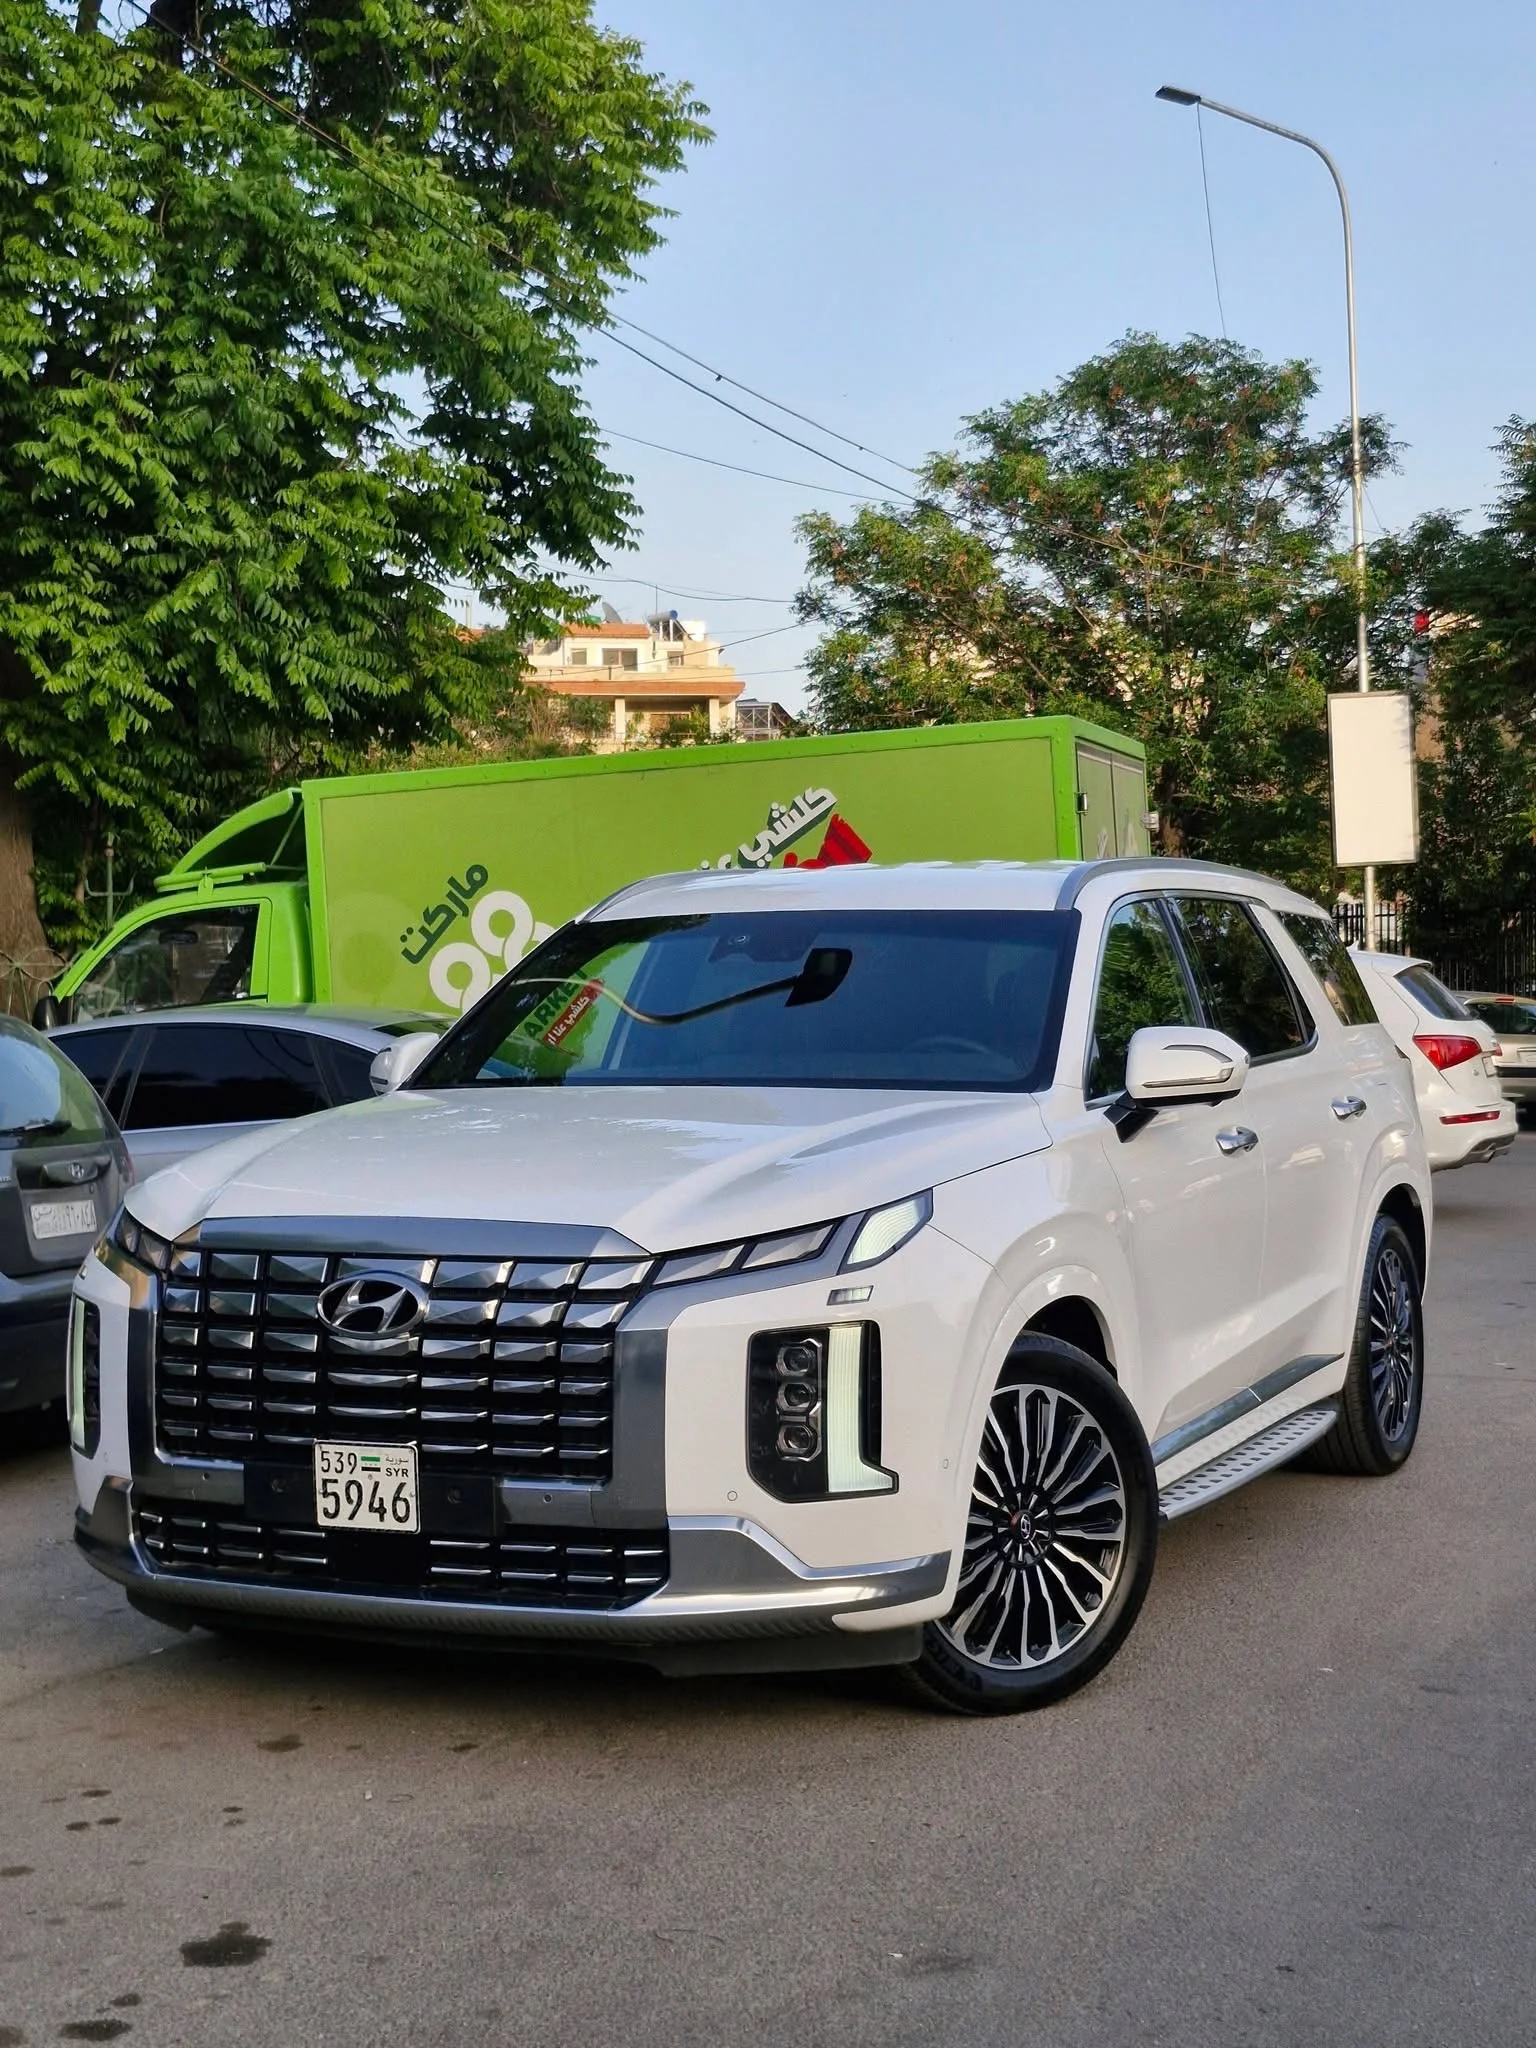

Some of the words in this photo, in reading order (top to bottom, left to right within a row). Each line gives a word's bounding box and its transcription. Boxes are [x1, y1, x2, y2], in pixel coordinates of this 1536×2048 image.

[738, 787, 838, 867] كلشي
[400, 864, 489, 964] ماركت
[523, 969, 588, 1039] ARKE
[321, 1451, 357, 1475] 539
[385, 1455, 409, 1466] سورية
[385, 1467, 409, 1478] SYR
[321, 1478, 411, 1523] 5946
